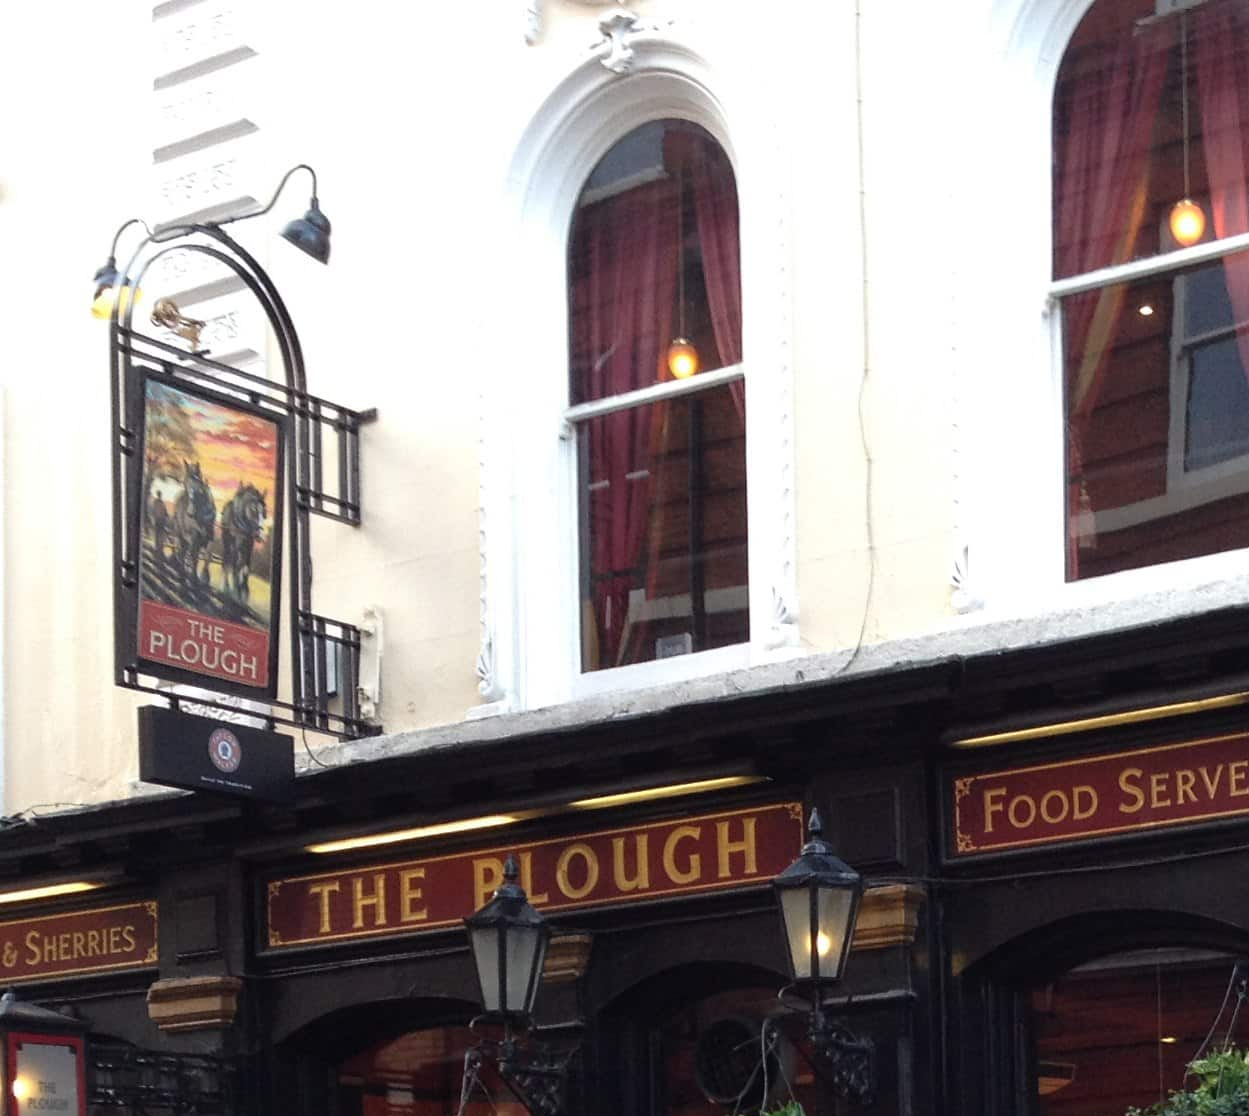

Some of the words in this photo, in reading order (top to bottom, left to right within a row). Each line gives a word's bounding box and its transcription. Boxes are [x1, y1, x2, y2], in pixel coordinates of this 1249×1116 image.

[187, 619, 225, 644] THE
[149, 630, 257, 680] PLOUGH
[982, 785, 1098, 833] FOOD
[309, 866, 429, 935] THE
[472, 816, 759, 912] PLOUGH
[2, 941, 19, 968] &
[25, 925, 136, 966] SHERRIES
[38, 1081, 57, 1094] THE
